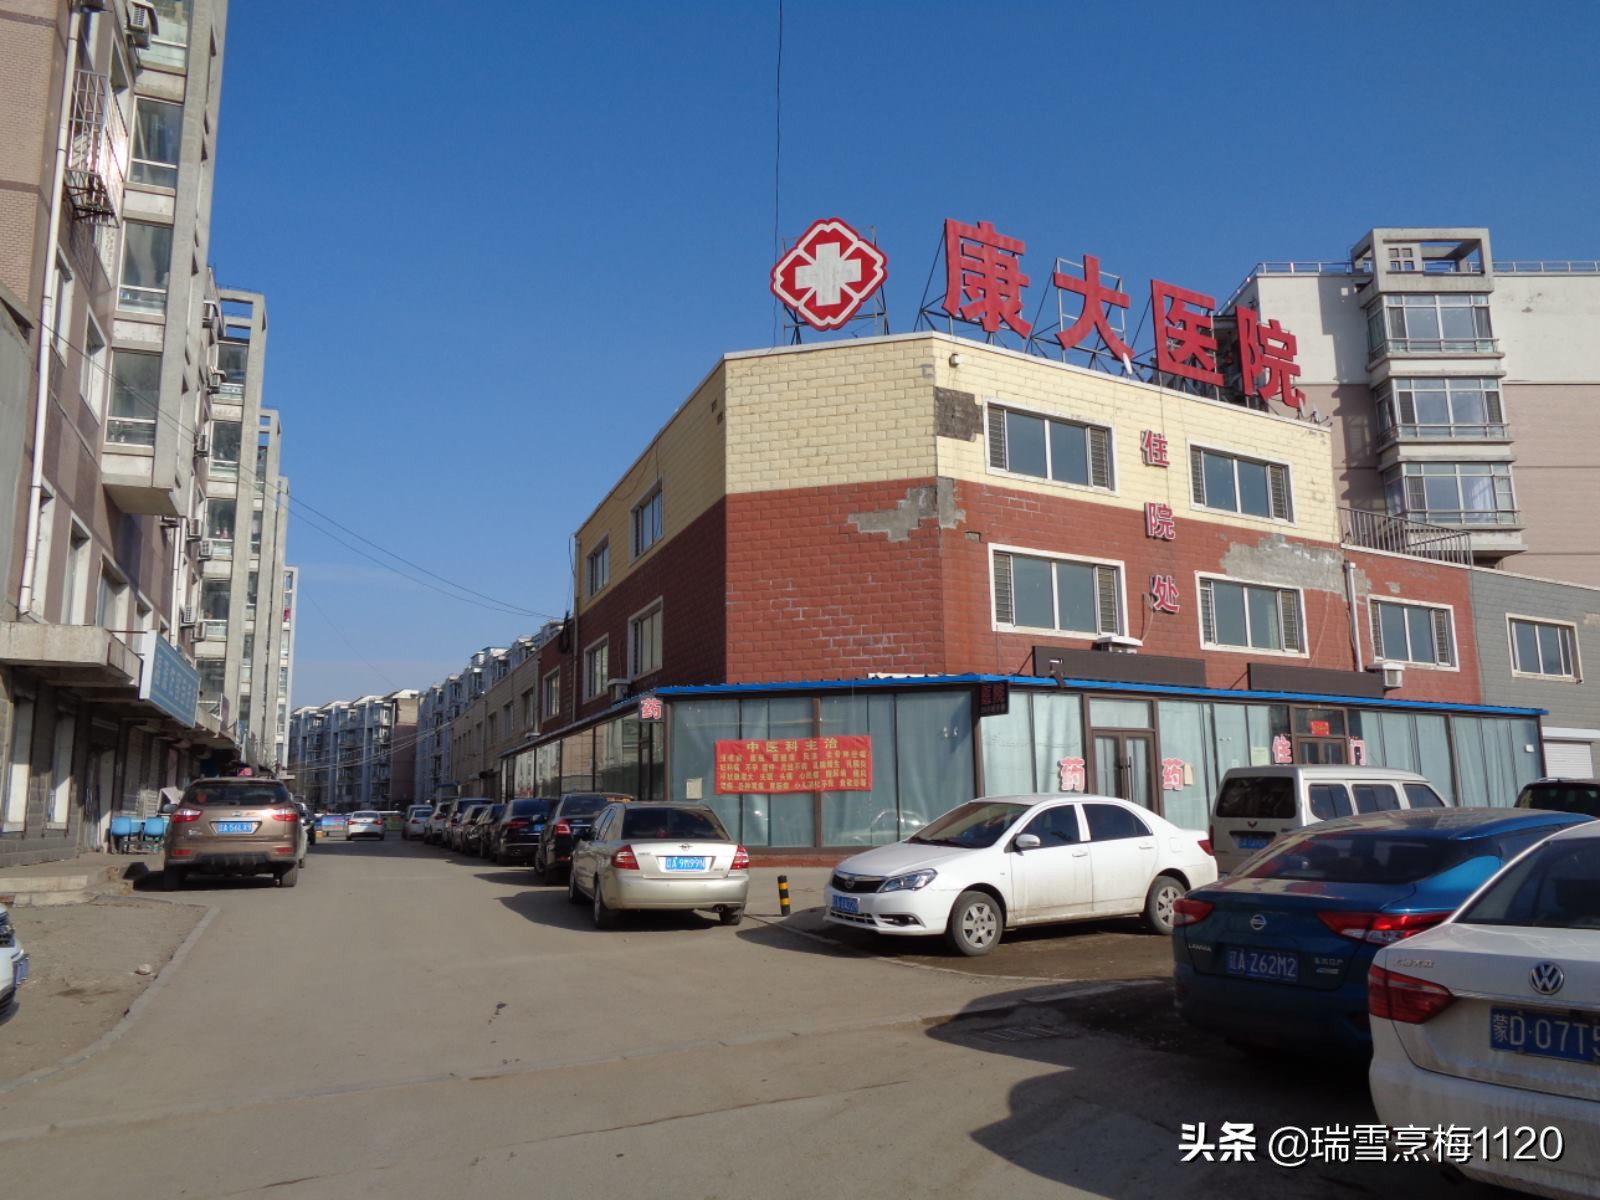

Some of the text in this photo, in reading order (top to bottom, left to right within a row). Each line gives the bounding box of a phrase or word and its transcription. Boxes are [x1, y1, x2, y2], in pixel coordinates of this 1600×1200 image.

[942, 218, 1306, 408] 康大医院
[1140, 428, 1181, 615] 住院处
[641, 697, 663, 720] 药
[746, 738, 837, 753] 中医科主治
[1060, 757, 1086, 791] 药
[1161, 758, 1185, 791] 药
